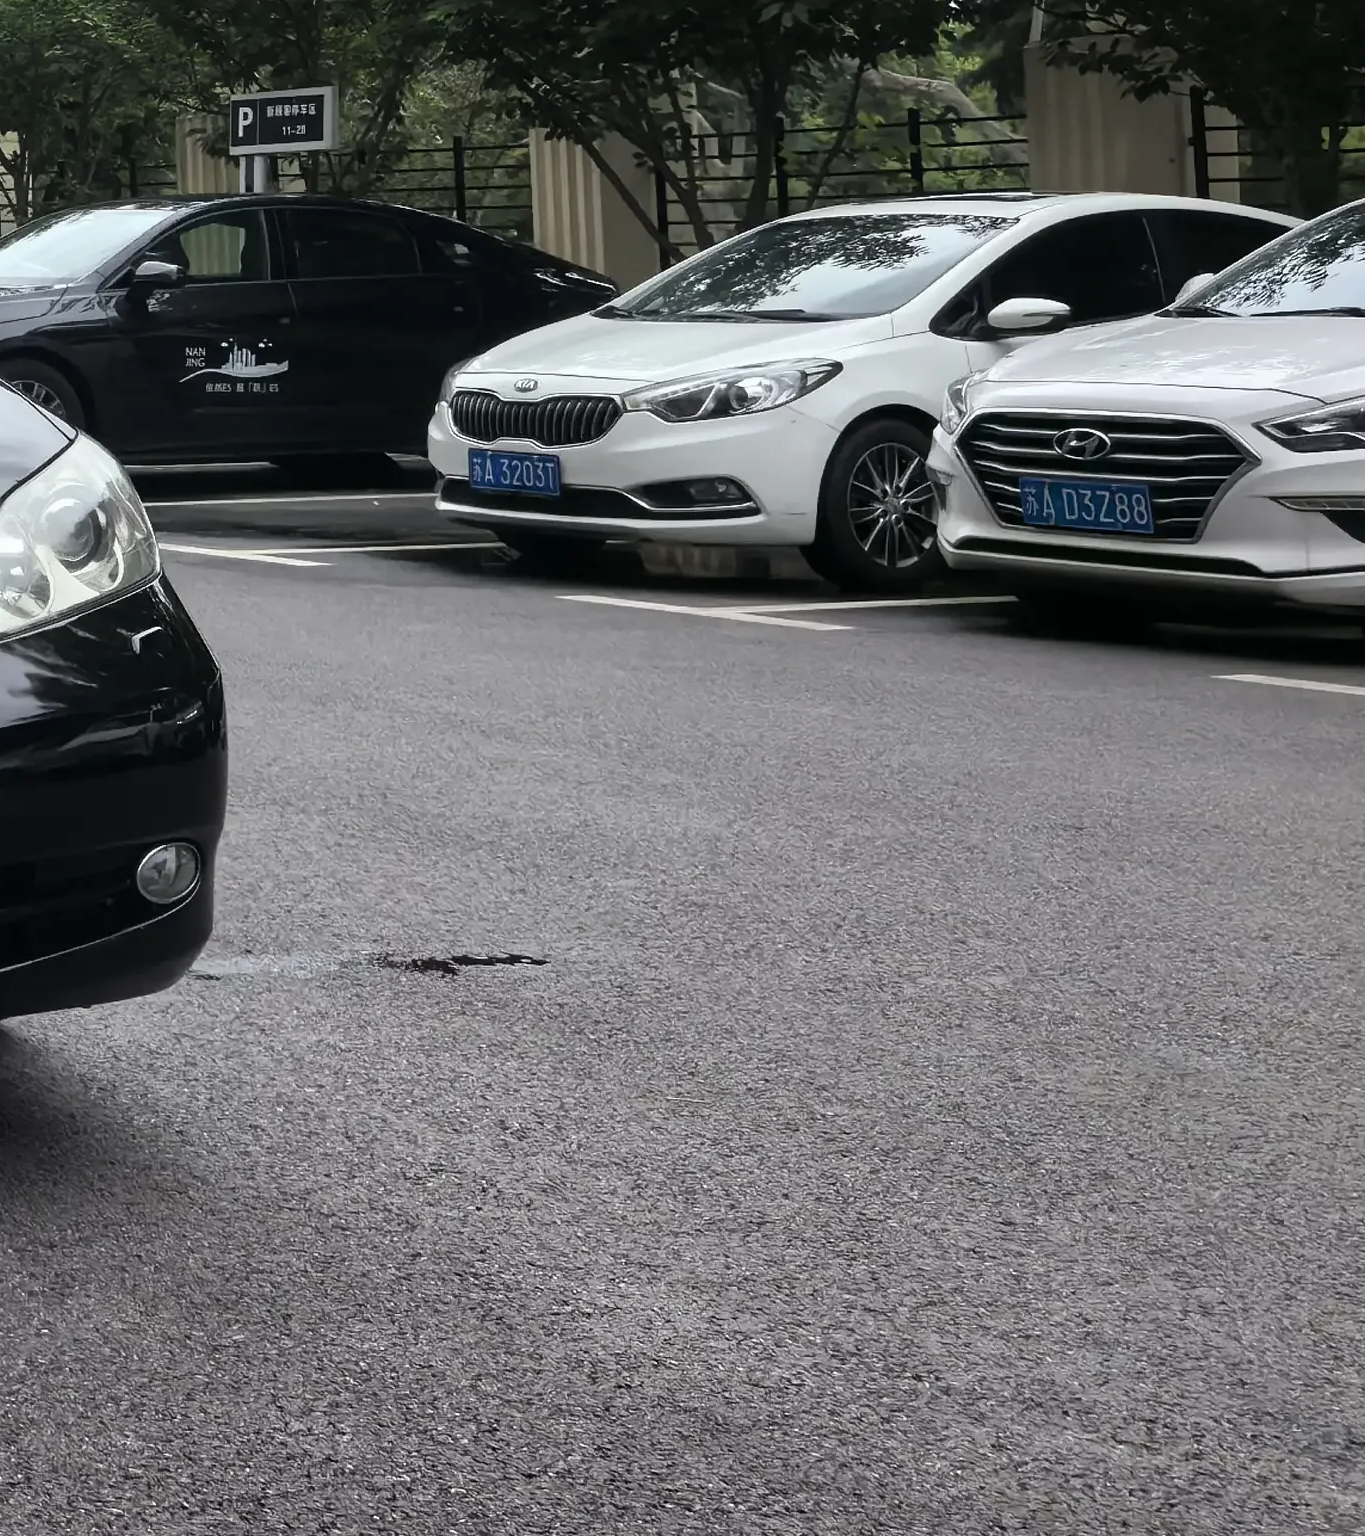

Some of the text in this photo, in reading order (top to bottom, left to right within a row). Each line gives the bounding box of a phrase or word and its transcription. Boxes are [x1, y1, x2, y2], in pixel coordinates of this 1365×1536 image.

[238, 106, 254, 138] P
[185, 346, 206, 357] NAN
[185, 358, 206, 367] JING
[515, 379, 537, 390] KIA
